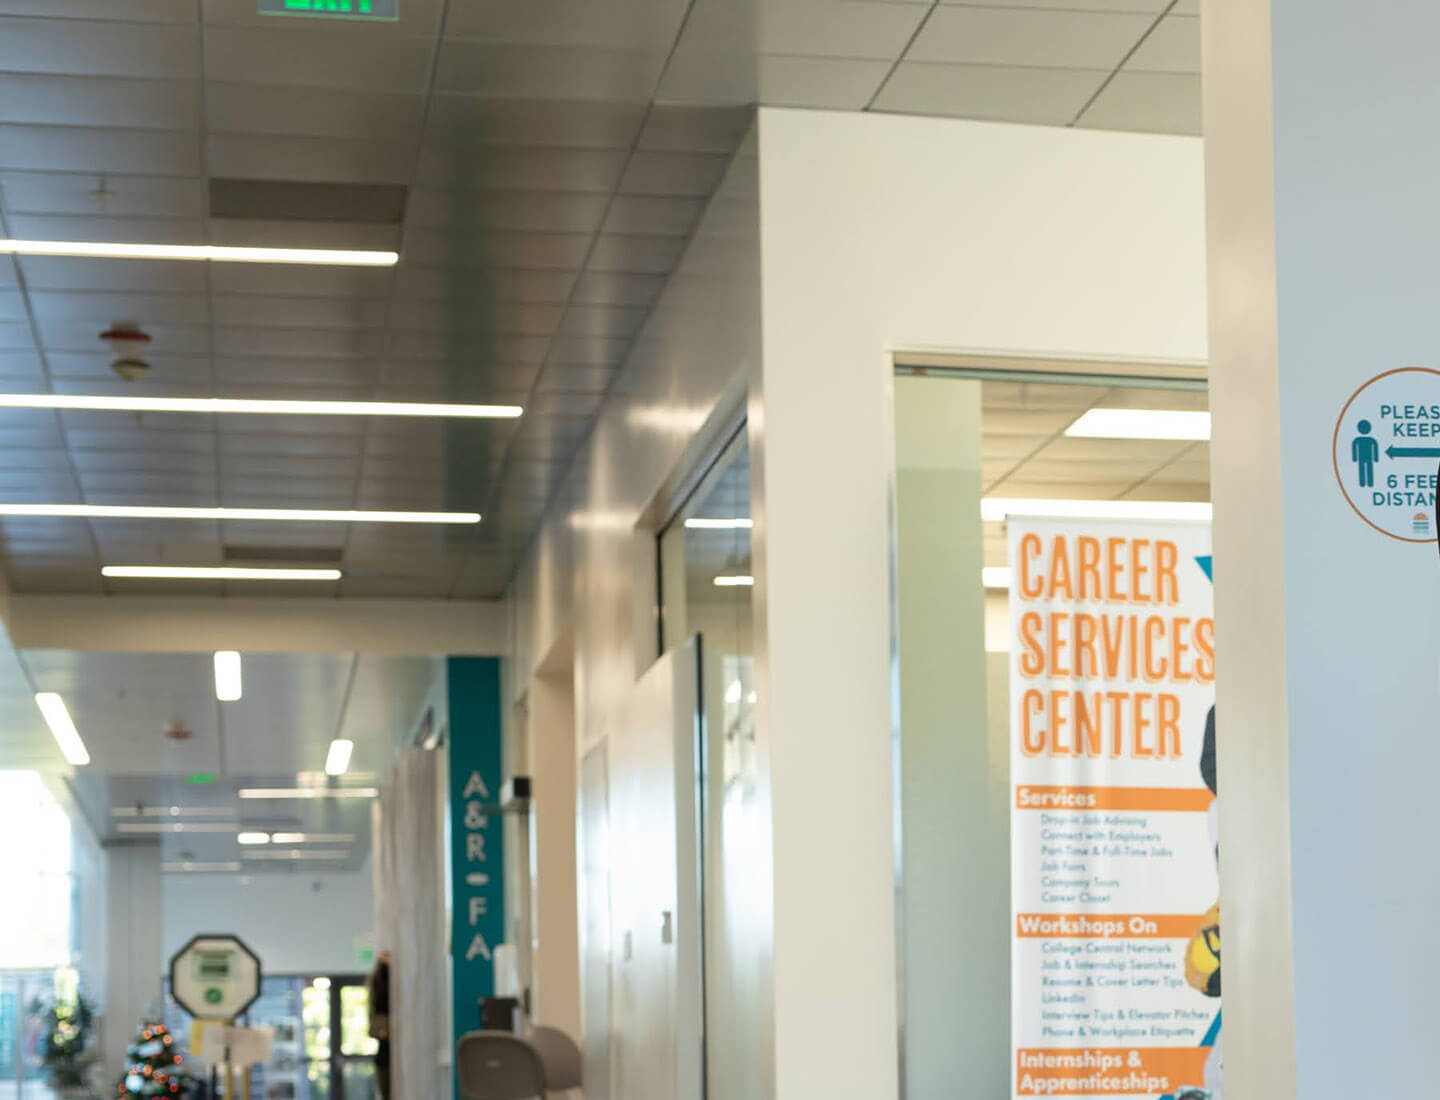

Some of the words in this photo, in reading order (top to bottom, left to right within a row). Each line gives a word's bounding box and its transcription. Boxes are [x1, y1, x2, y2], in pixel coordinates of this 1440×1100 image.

[1387, 474, 1397, 488] 6
[1405, 474, 1438, 488] FEE
[1373, 492, 1436, 506] DISTA
[1018, 533, 1180, 606] CAREER
[1018, 611, 1216, 684] SERVICES
[1020, 688, 1182, 760] CENTER
[1019, 788, 1097, 807] Services
[1019, 916, 1125, 937] Workshops
[1129, 916, 1157, 934] On
[1020, 1052, 1122, 1073] Internships
[1127, 1051, 1142, 1068] &
[1020, 1073, 1169, 1093] Apprenticeships
